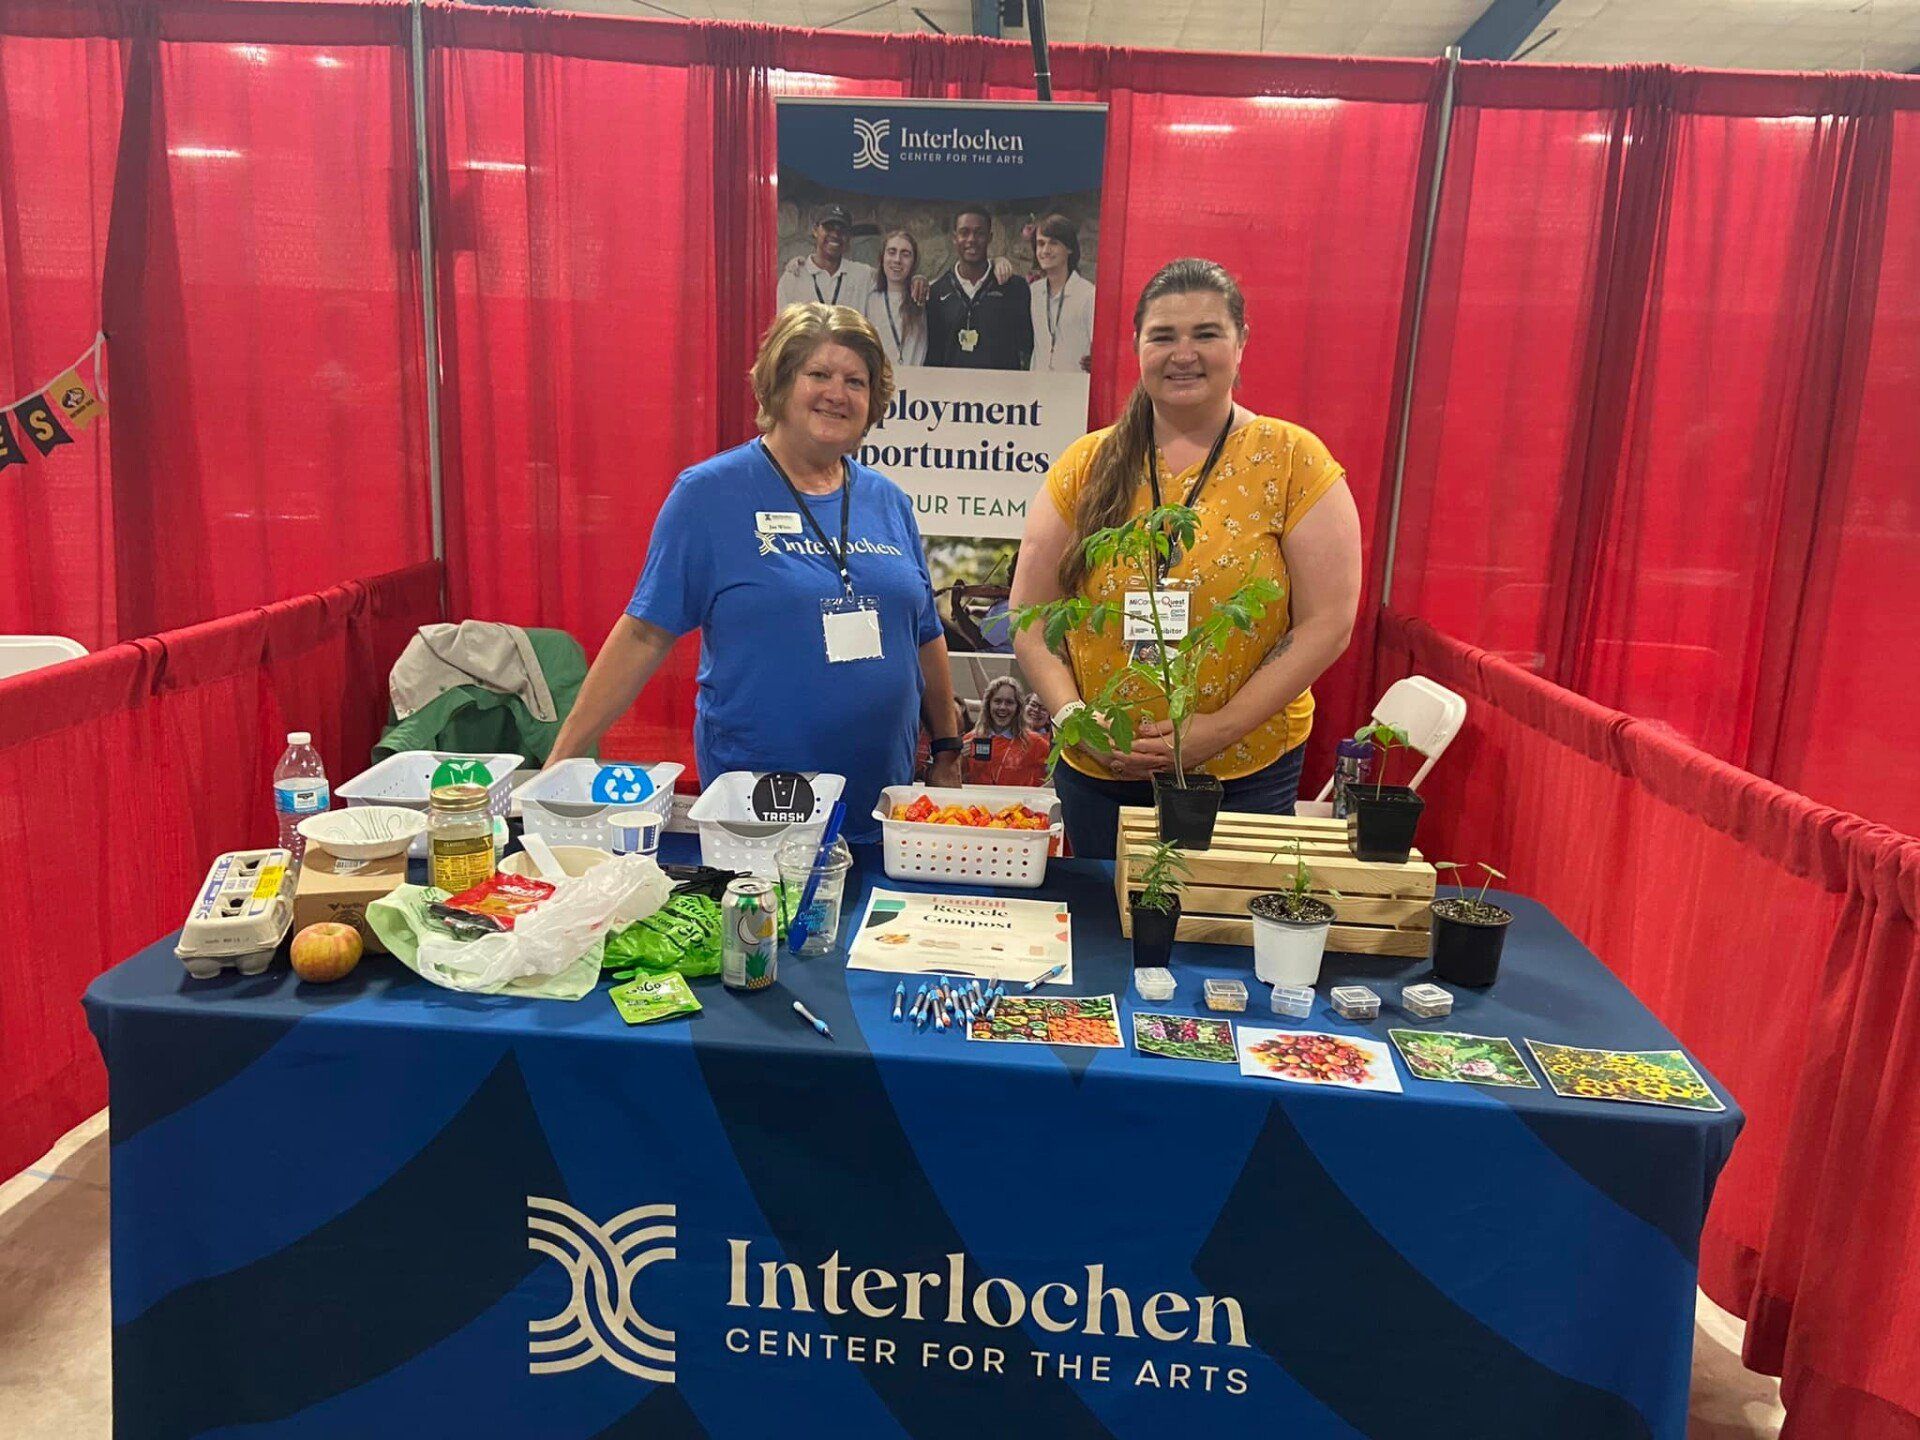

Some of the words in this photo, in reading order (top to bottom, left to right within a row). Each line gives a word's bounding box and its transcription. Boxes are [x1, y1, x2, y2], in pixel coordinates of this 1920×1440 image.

[900, 128, 1023, 151] Interlochen
[900, 152, 942, 163] CENTER
[946, 153, 968, 163] FOR
[972, 154, 993, 164] THE
[997, 155, 1024, 165] ARTS
[877, 390, 1042, 431] ployment
[852, 440, 1049, 474] portunities
[957, 496, 1026, 517] TEAM
[781, 537, 902, 556] Intelochen
[762, 812, 804, 822] TRASH
[923, 914, 1012, 929] Compost
[933, 905, 1008, 917] Recycle
[726, 1238, 1251, 1348] Interlochen
[725, 1327, 897, 1365] CENTER
[922, 1342, 1005, 1374] FOR
[1030, 1351, 1111, 1382] THE
[1134, 1360, 1249, 1394] ARTS
